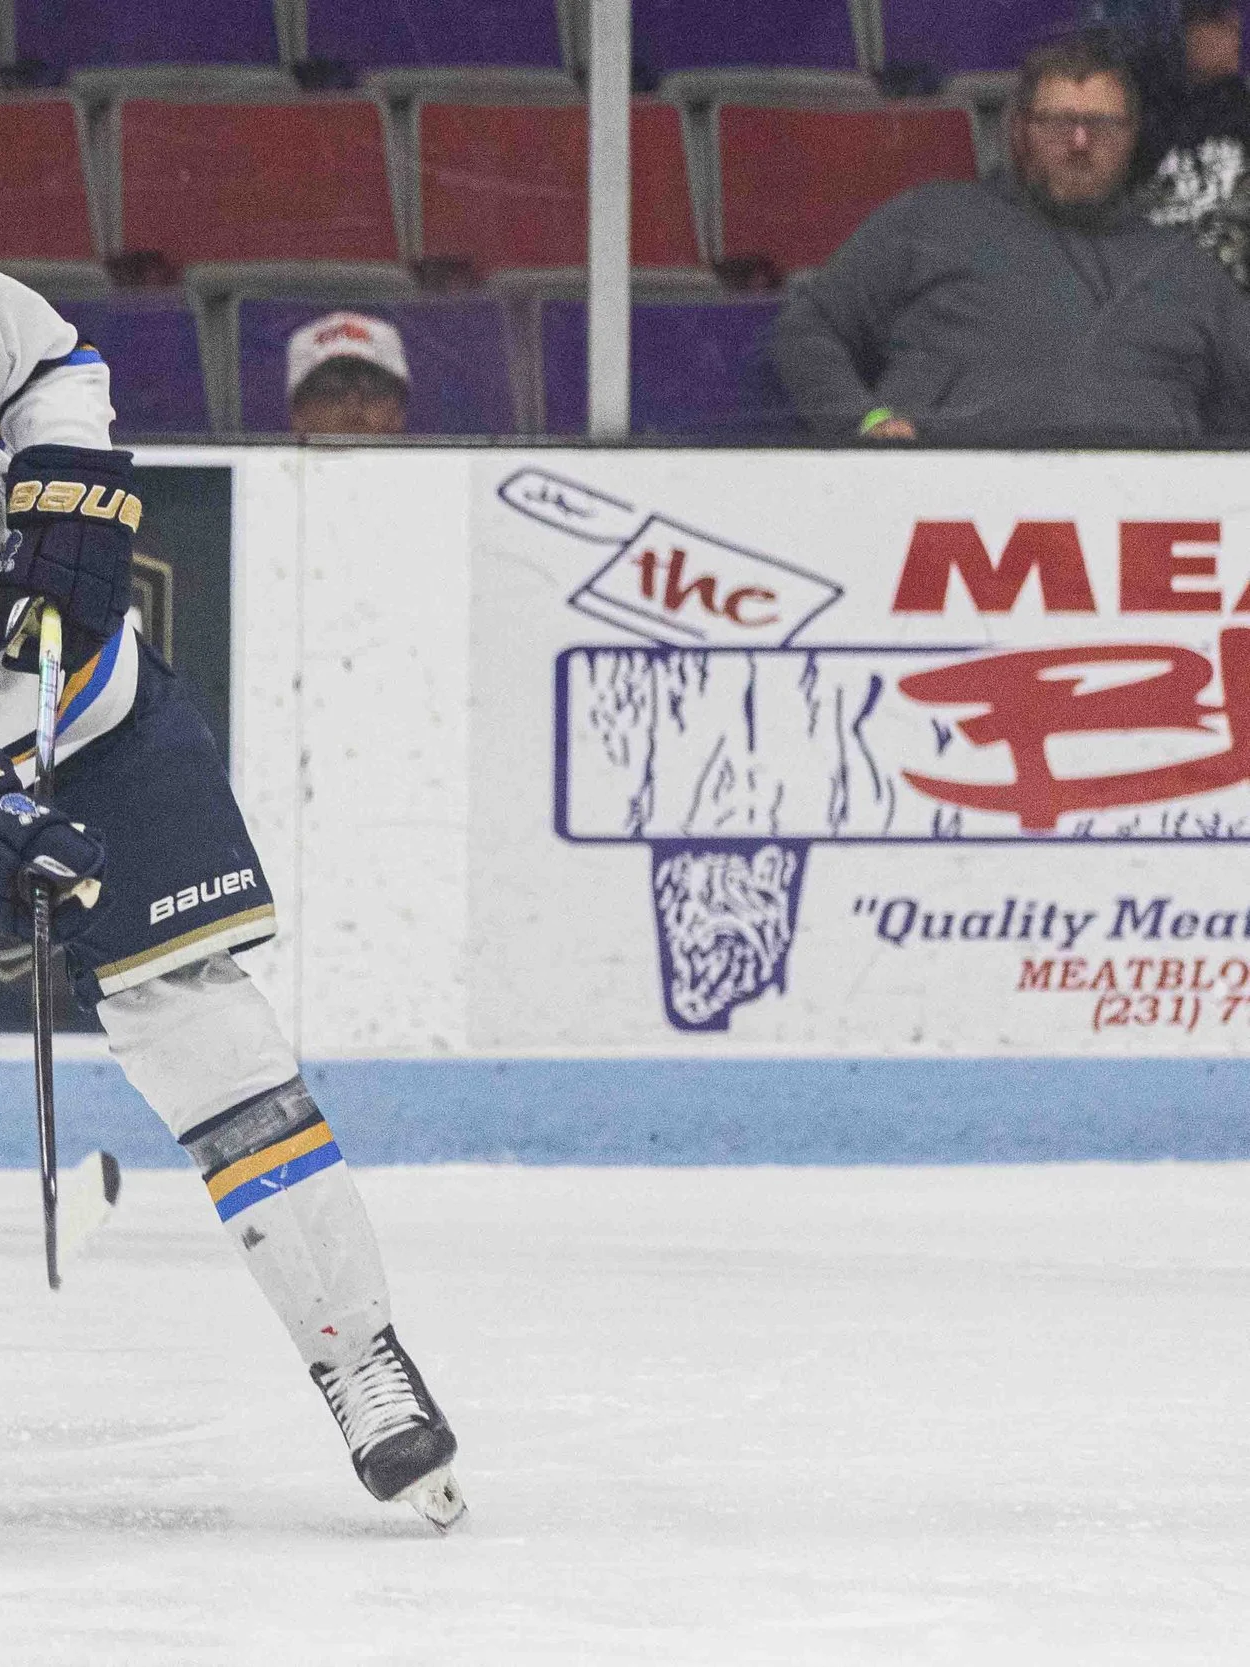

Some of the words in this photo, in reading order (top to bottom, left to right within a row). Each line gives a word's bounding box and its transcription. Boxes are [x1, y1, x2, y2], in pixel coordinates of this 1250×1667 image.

[631, 547, 781, 628] thc
[891, 519, 1250, 614] ME
[1092, 995, 1202, 1032] (231)
[1222, 995, 1250, 1025] 7
